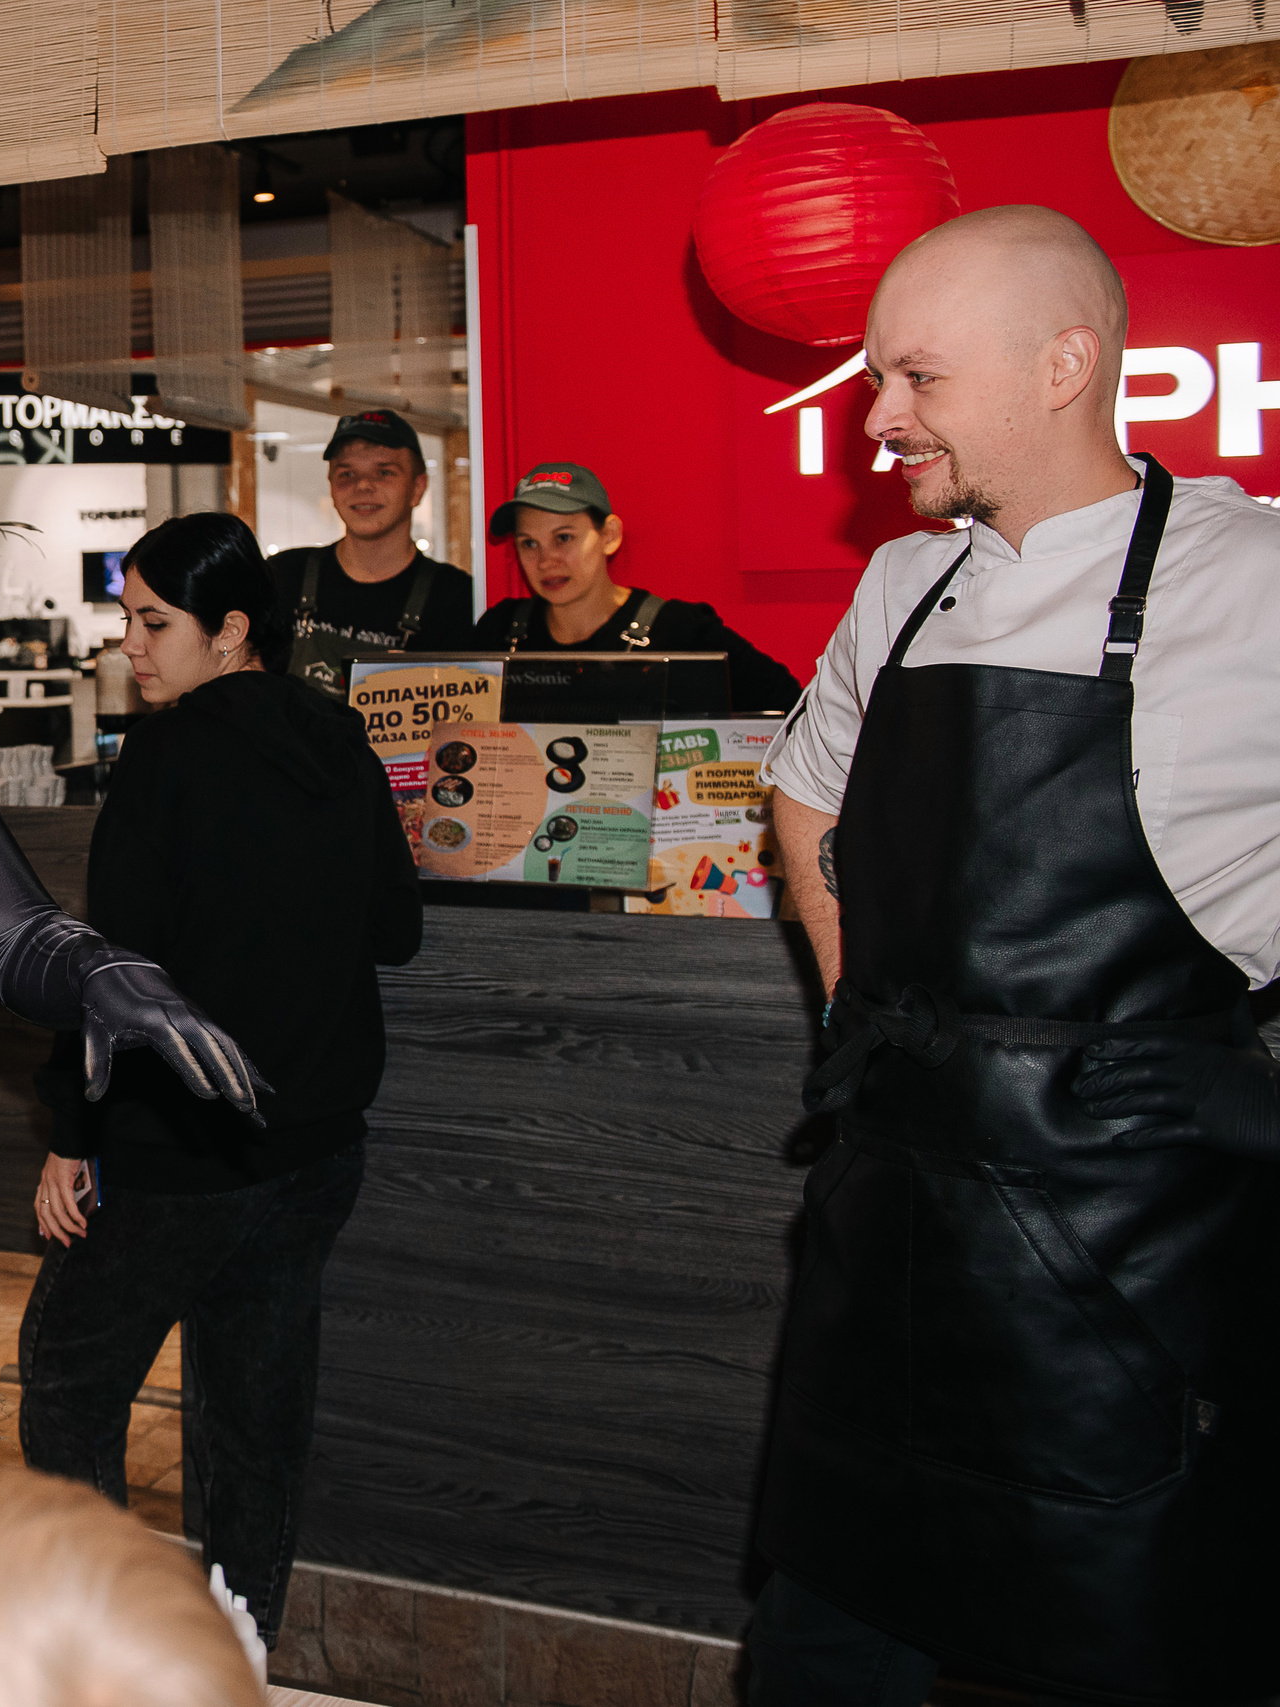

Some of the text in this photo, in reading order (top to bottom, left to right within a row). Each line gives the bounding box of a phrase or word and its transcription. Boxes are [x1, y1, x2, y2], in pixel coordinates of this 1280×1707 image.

[8, 429, 183, 447] STORE
[356, 676, 489, 706] ОПЛАЧИВАЙ
[366, 701, 474, 733] ДО 50%
[489, 730, 517, 738] МЕНЮ
[586, 729, 631, 737] НОВИНКИ
[695, 769, 755, 778] И ПОЛУЧИ
[696, 780, 755, 790] ЛИМОНАД
[565, 805, 632, 816] ЛЕТНЕЕ МЕНЮ
